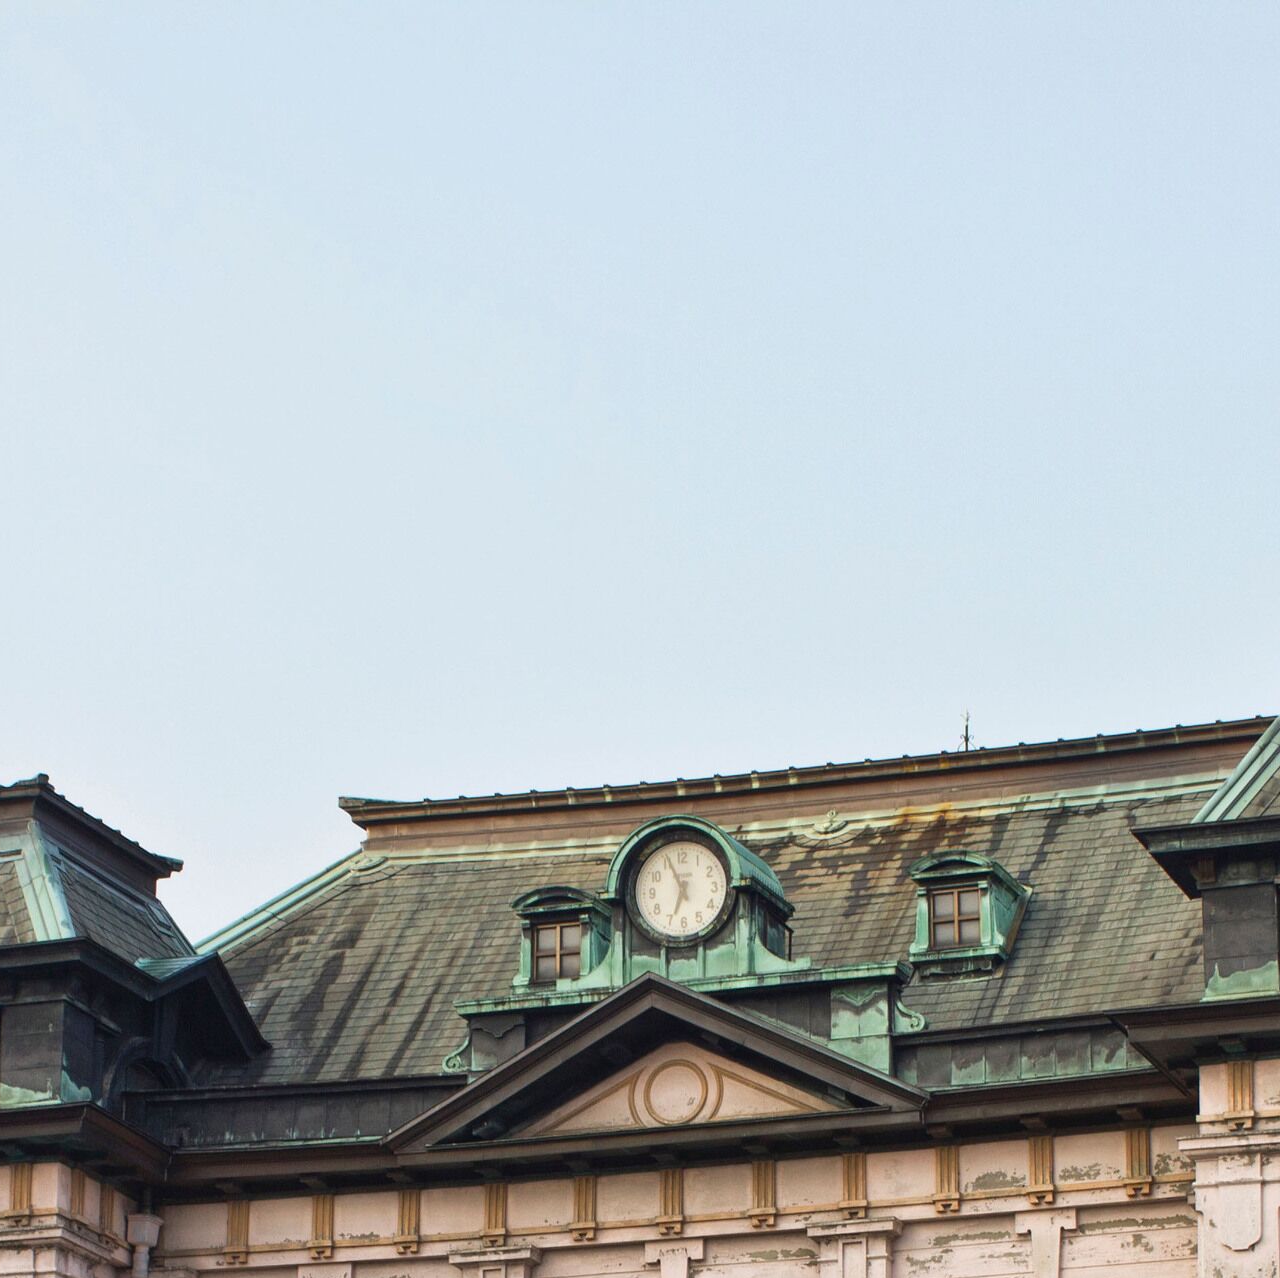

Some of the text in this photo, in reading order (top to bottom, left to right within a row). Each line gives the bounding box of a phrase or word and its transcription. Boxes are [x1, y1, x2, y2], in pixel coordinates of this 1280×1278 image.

[677, 852, 688, 864] 12
[652, 871, 661, 883] 10
[706, 866, 713, 878] 2
[711, 881, 718, 893] 3
[649, 888, 656, 899] 9
[653, 903, 660, 915] 8
[707, 899, 715, 909] 4
[666, 914, 673, 926] 7
[681, 917, 688, 928] 6
[695, 912, 703, 923] 5
